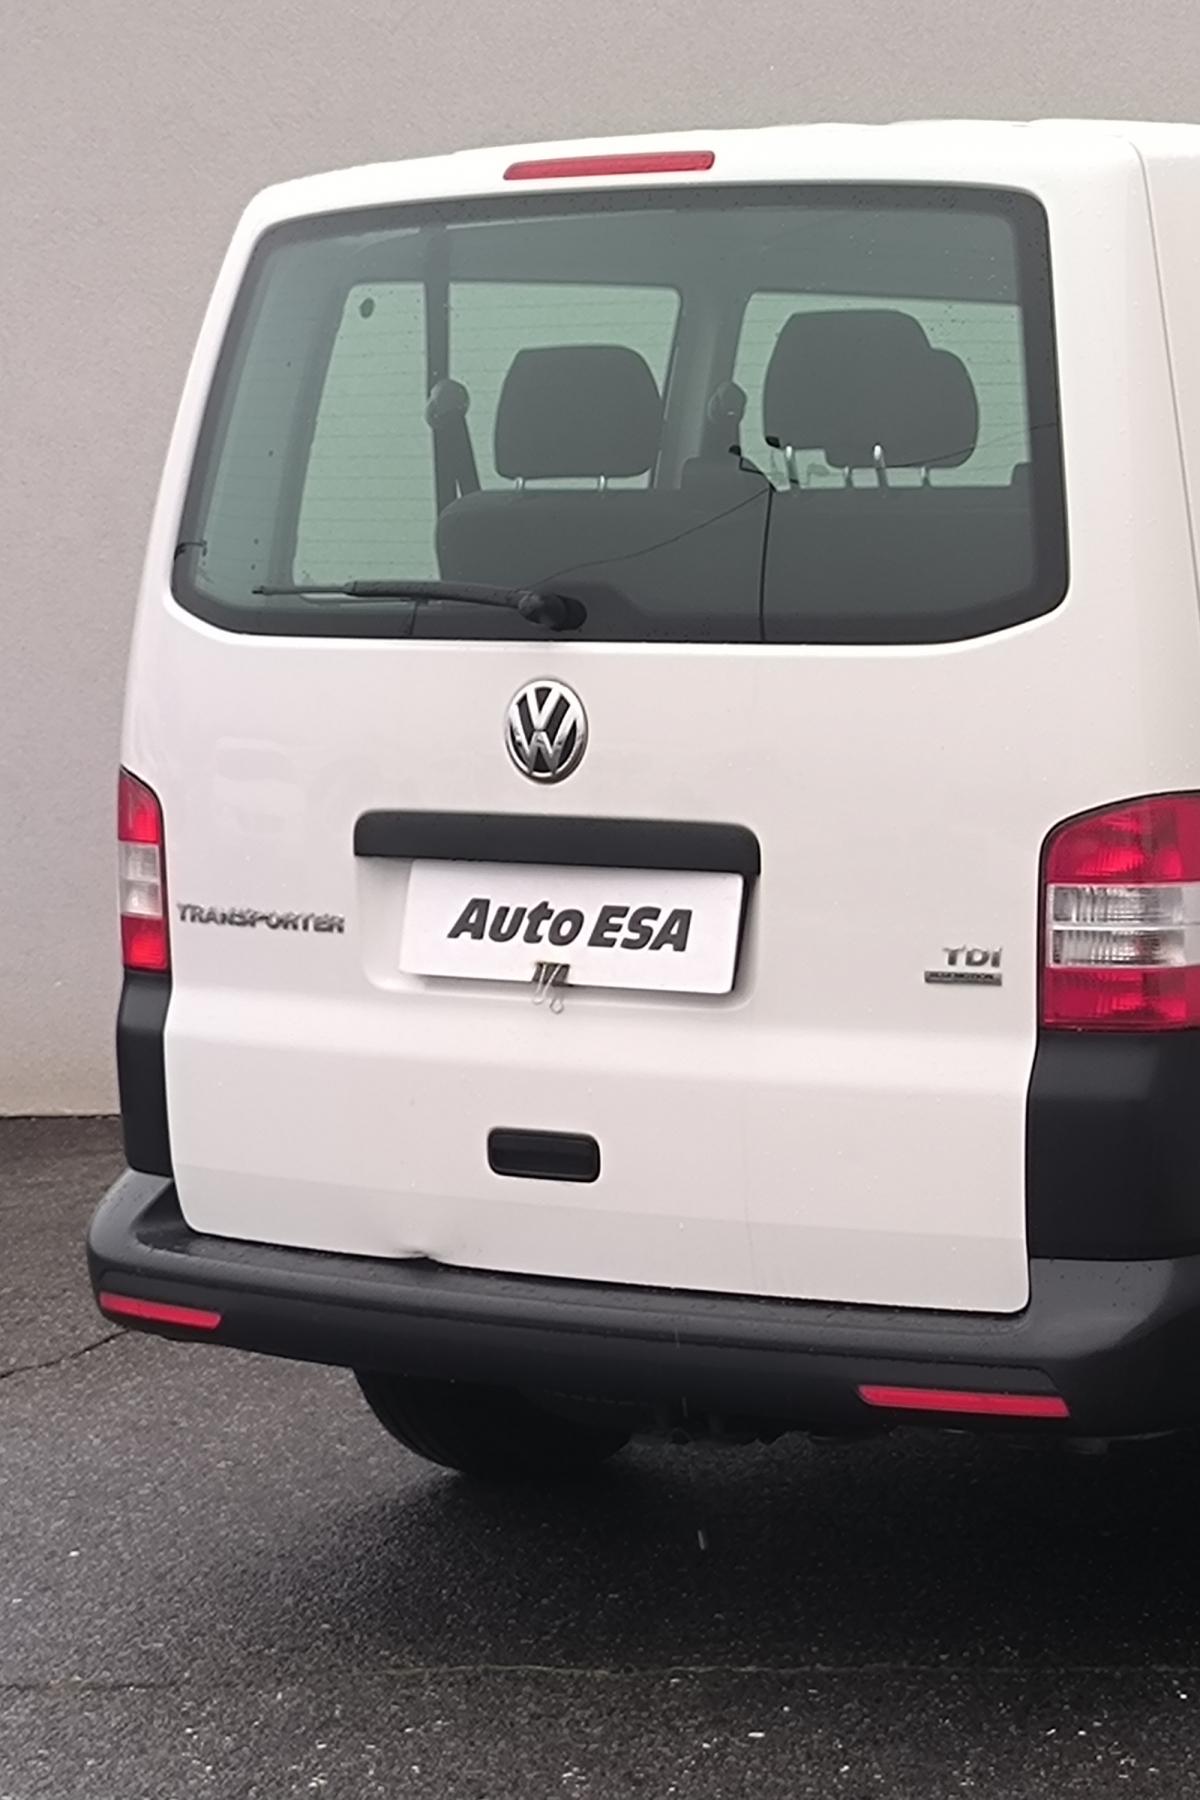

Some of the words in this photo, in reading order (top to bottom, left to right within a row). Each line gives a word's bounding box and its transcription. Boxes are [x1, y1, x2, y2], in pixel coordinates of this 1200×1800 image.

[508, 681, 582, 777] VW
[176, 903, 345, 933] TRANSPORTER
[447, 897, 585, 946] Auto
[587, 905, 693, 952] ESA
[942, 946, 1003, 967] TDI
